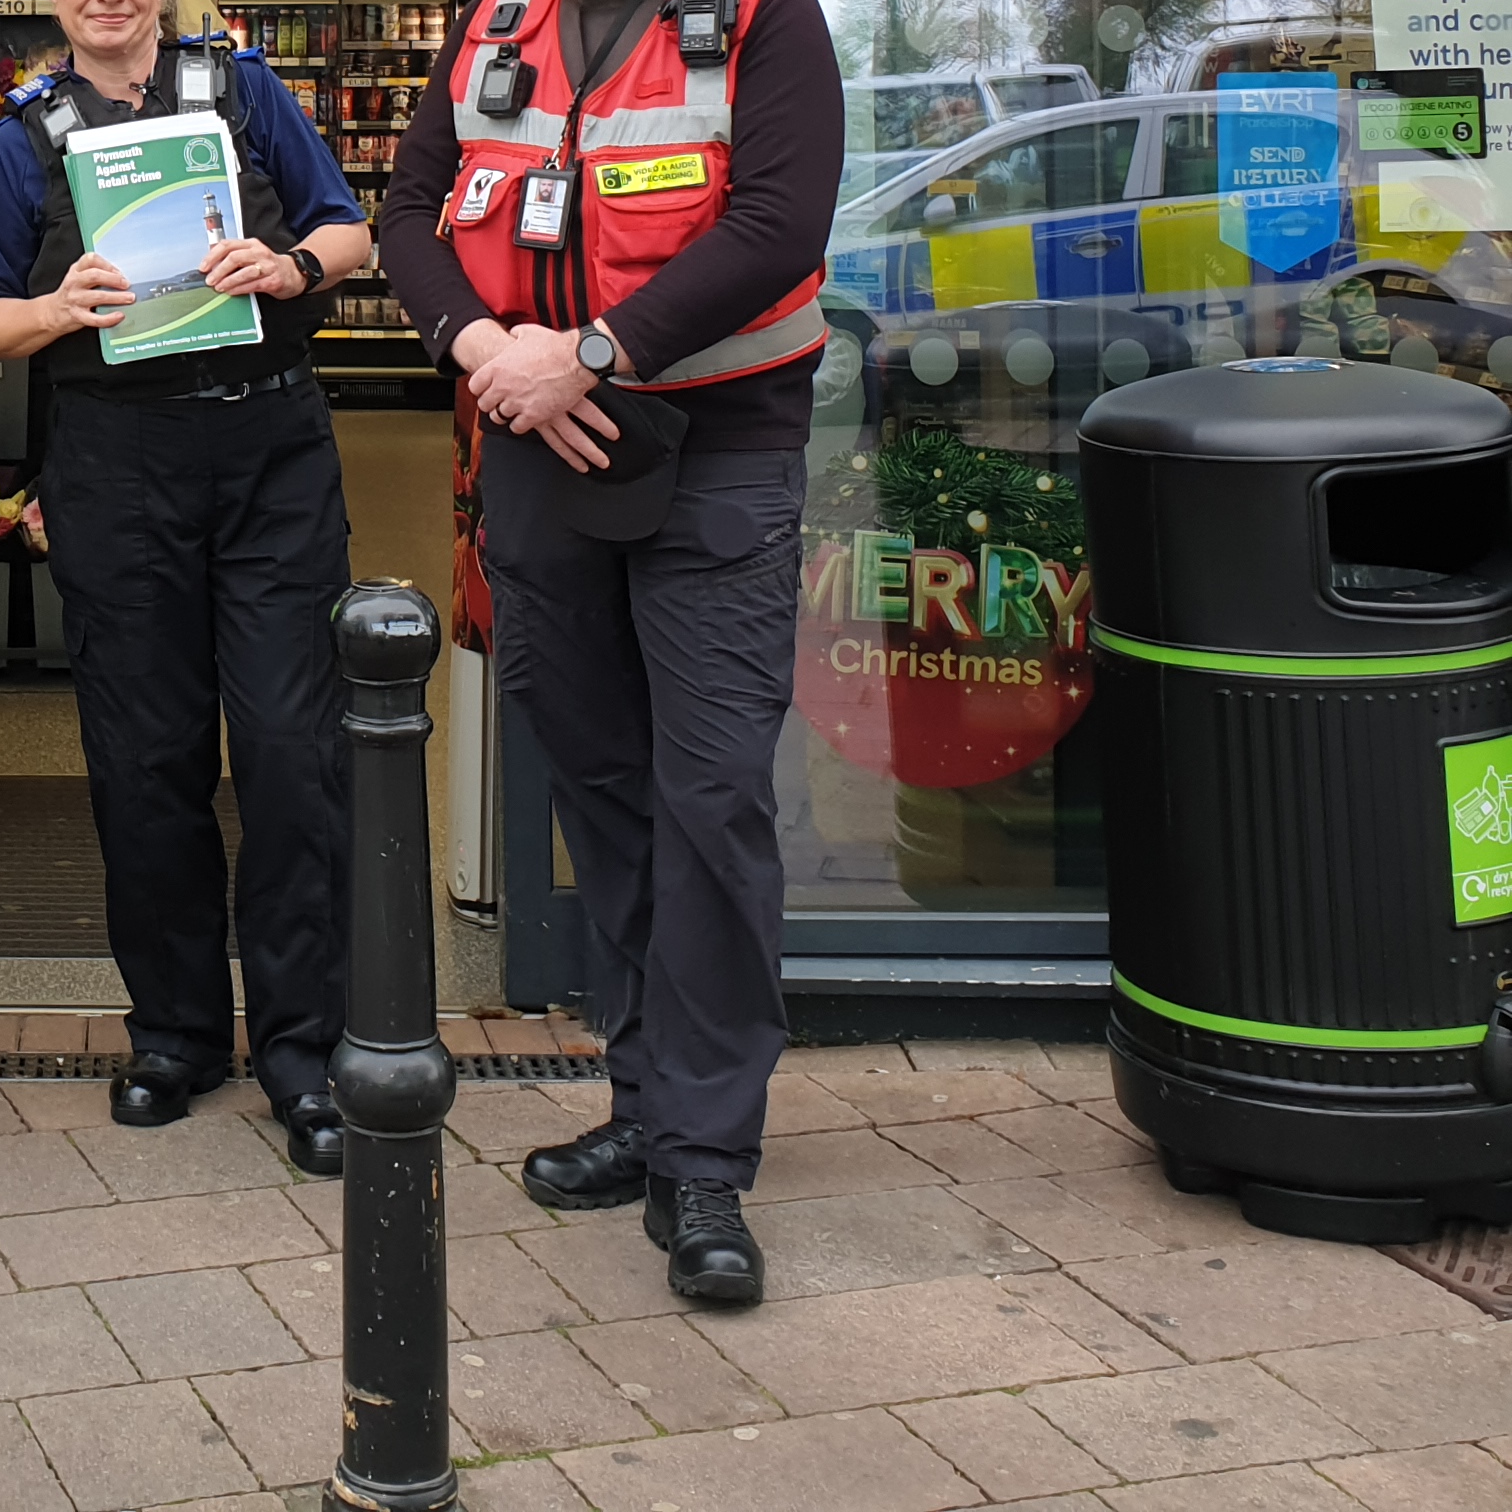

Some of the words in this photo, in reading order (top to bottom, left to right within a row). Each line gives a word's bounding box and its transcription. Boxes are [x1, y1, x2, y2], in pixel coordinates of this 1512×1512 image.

[1408, 9, 1459, 31] and
[1410, 42, 1469, 66] with
[1480, 42, 1512, 65] he
[1240, 90, 1313, 112] EVRi
[1364, 103, 1393, 112] FOOD
[1395, 102, 1436, 111] HYGIENE
[1438, 101, 1472, 110] RATING
[1457, 124, 1469, 139] 5
[93, 146, 143, 163] Plymouth
[1250, 147, 1305, 163] SEND
[96, 160, 136, 176] Against
[633, 165, 658, 175] VIDEO
[670, 160, 697, 170] AUDIO
[98, 174, 128, 189] Retail
[130, 171, 161, 183] Crime
[641, 170, 693, 183] RECORDING
[1233, 169, 1321, 185] RETURN
[1228, 190, 1328, 207] COLLECT
[829, 637, 1044, 687] Christmas
[1493, 870, 1509, 885] dry
